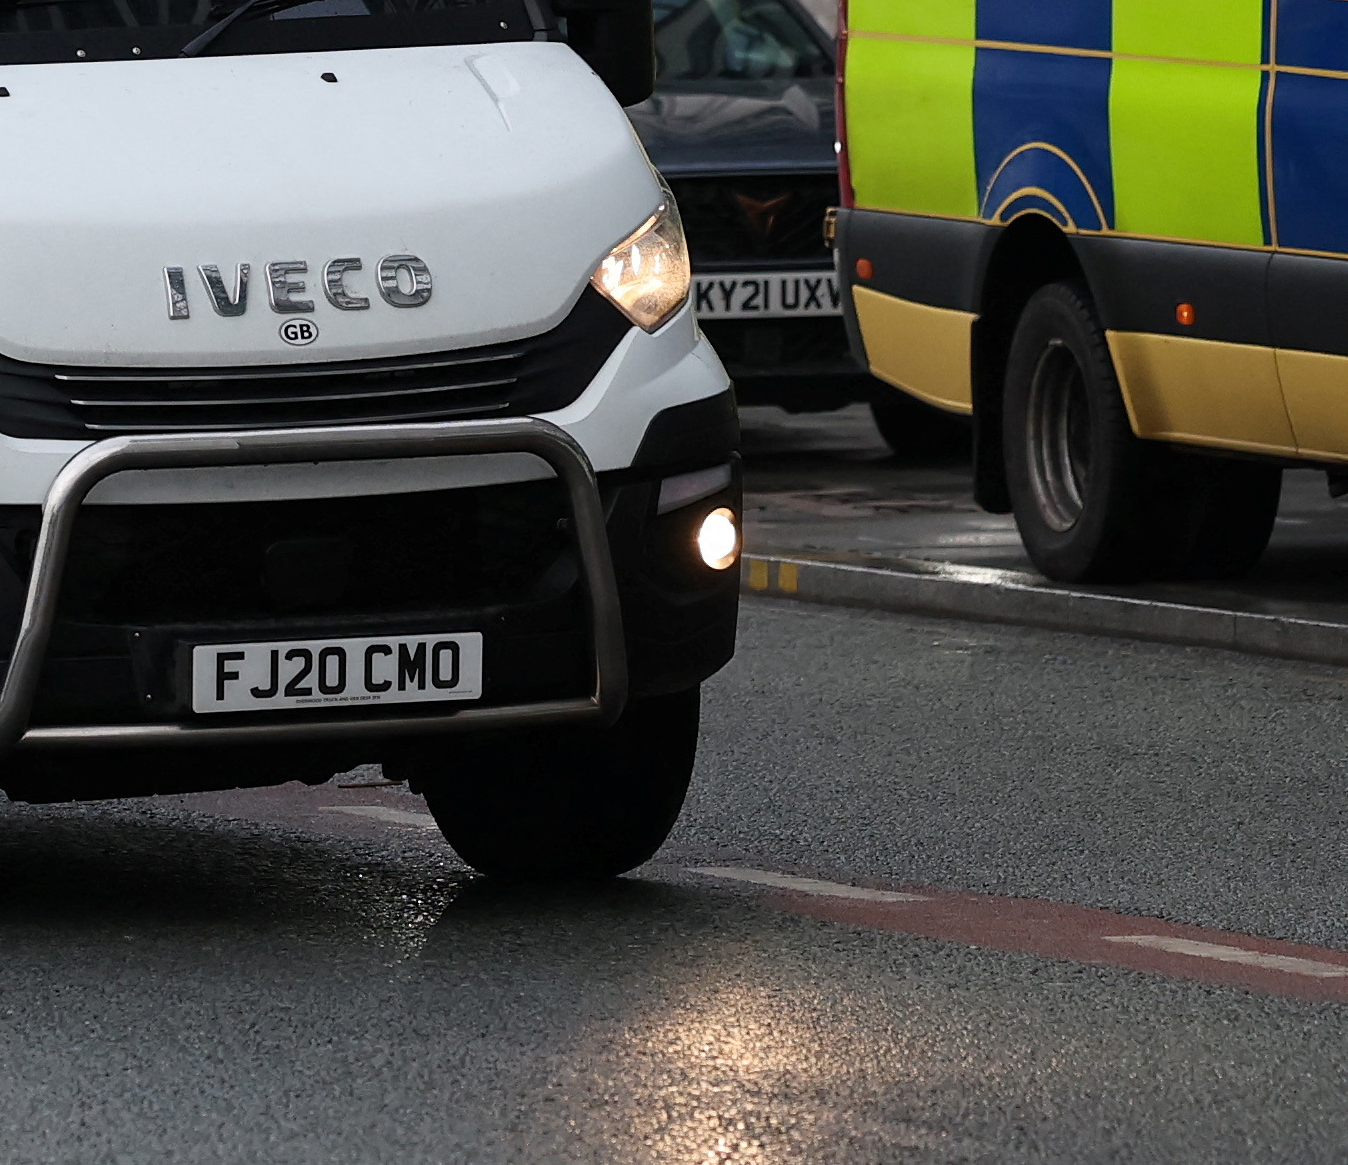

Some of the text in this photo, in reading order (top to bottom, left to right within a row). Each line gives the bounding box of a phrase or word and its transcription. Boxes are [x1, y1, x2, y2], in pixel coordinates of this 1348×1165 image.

[162, 254, 433, 320] IVECO
[696, 280, 769, 312] KY21
[283, 321, 313, 343] GB
[215, 641, 460, 701] FJ20 CMO
